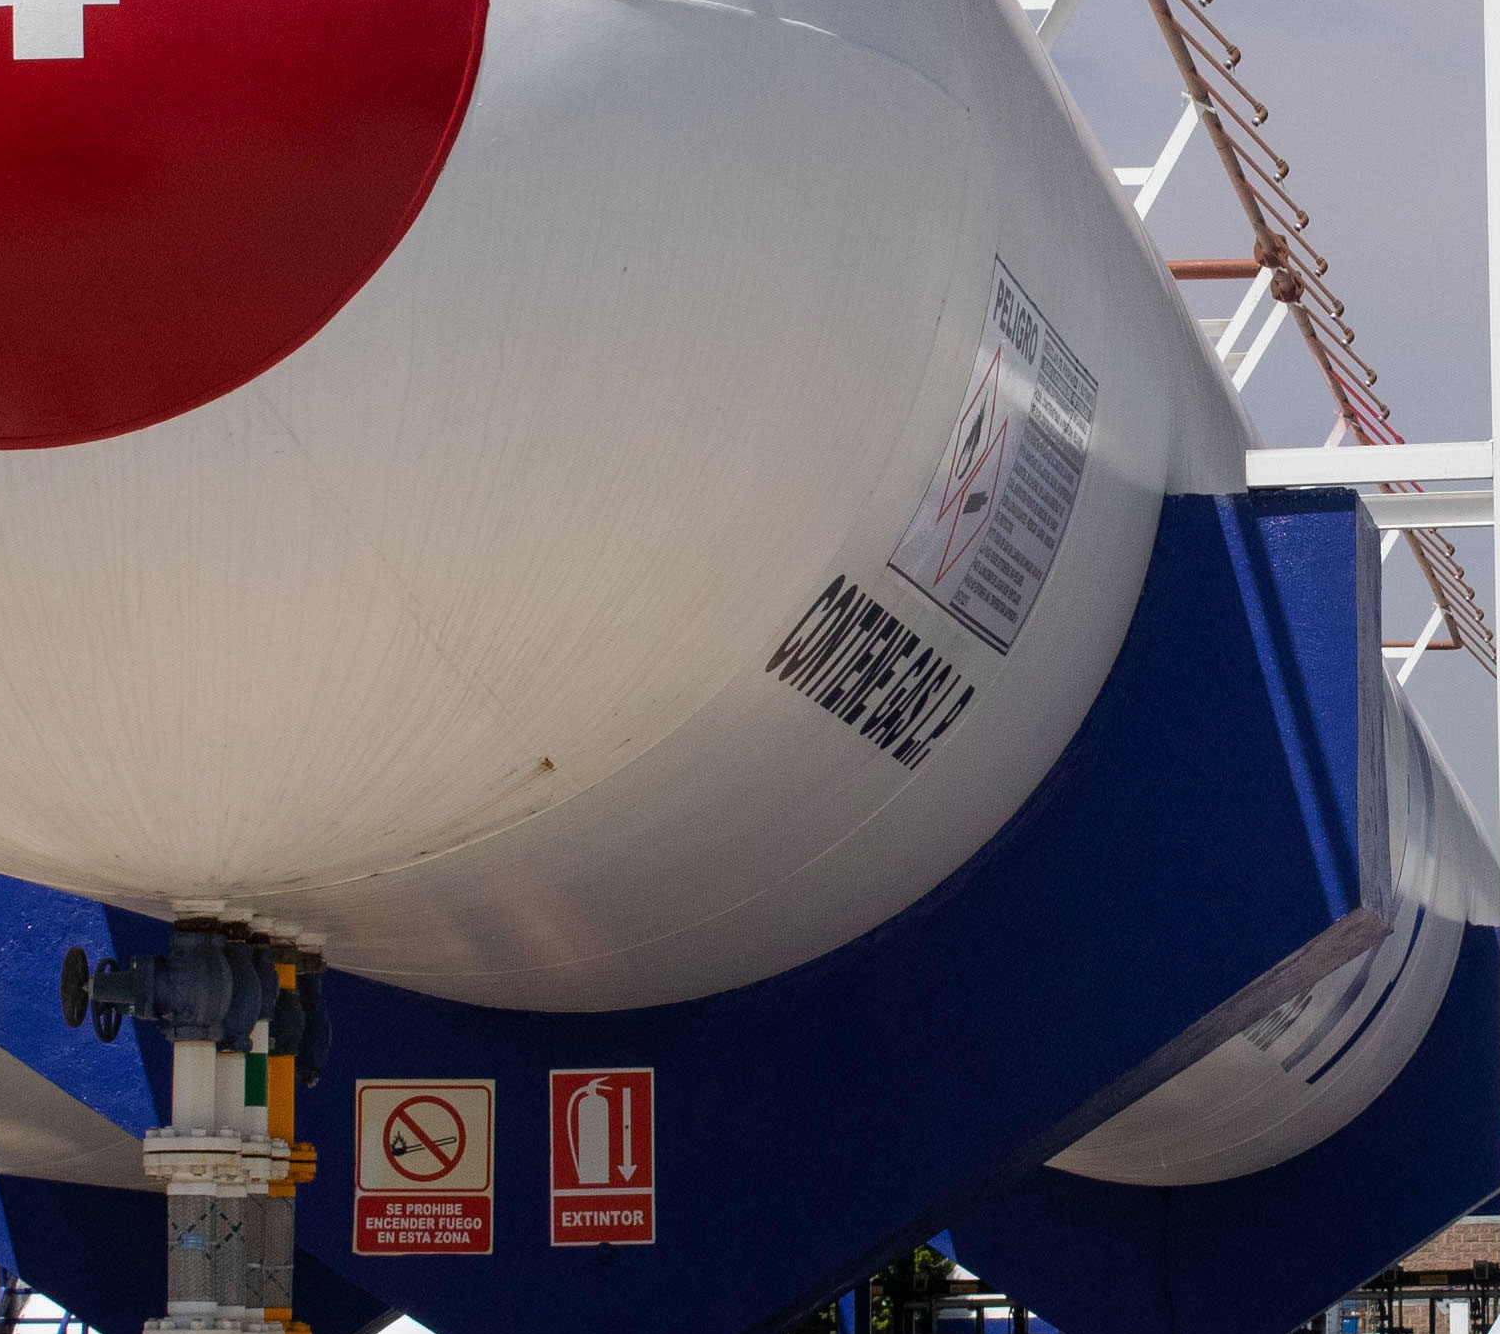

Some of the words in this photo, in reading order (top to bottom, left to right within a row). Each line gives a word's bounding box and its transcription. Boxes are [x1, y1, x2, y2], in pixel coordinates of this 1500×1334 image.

[993, 277, 1039, 366] PELIGRO
[765, 574, 921, 726] CONTIENE
[859, 646, 952, 750] GAS
[891, 674, 975, 771] L.P.
[365, 1217, 435, 1229] ENCENDER
[439, 1217, 483, 1229] FUEGO
[386, 1204, 403, 1215] SE
[406, 1204, 463, 1215] PROHIBE
[561, 1210, 644, 1228] EXTINTOR
[378, 1232, 395, 1244] EN
[399, 1232, 431, 1244] ESTA
[434, 1232, 471, 1244] ZONA
